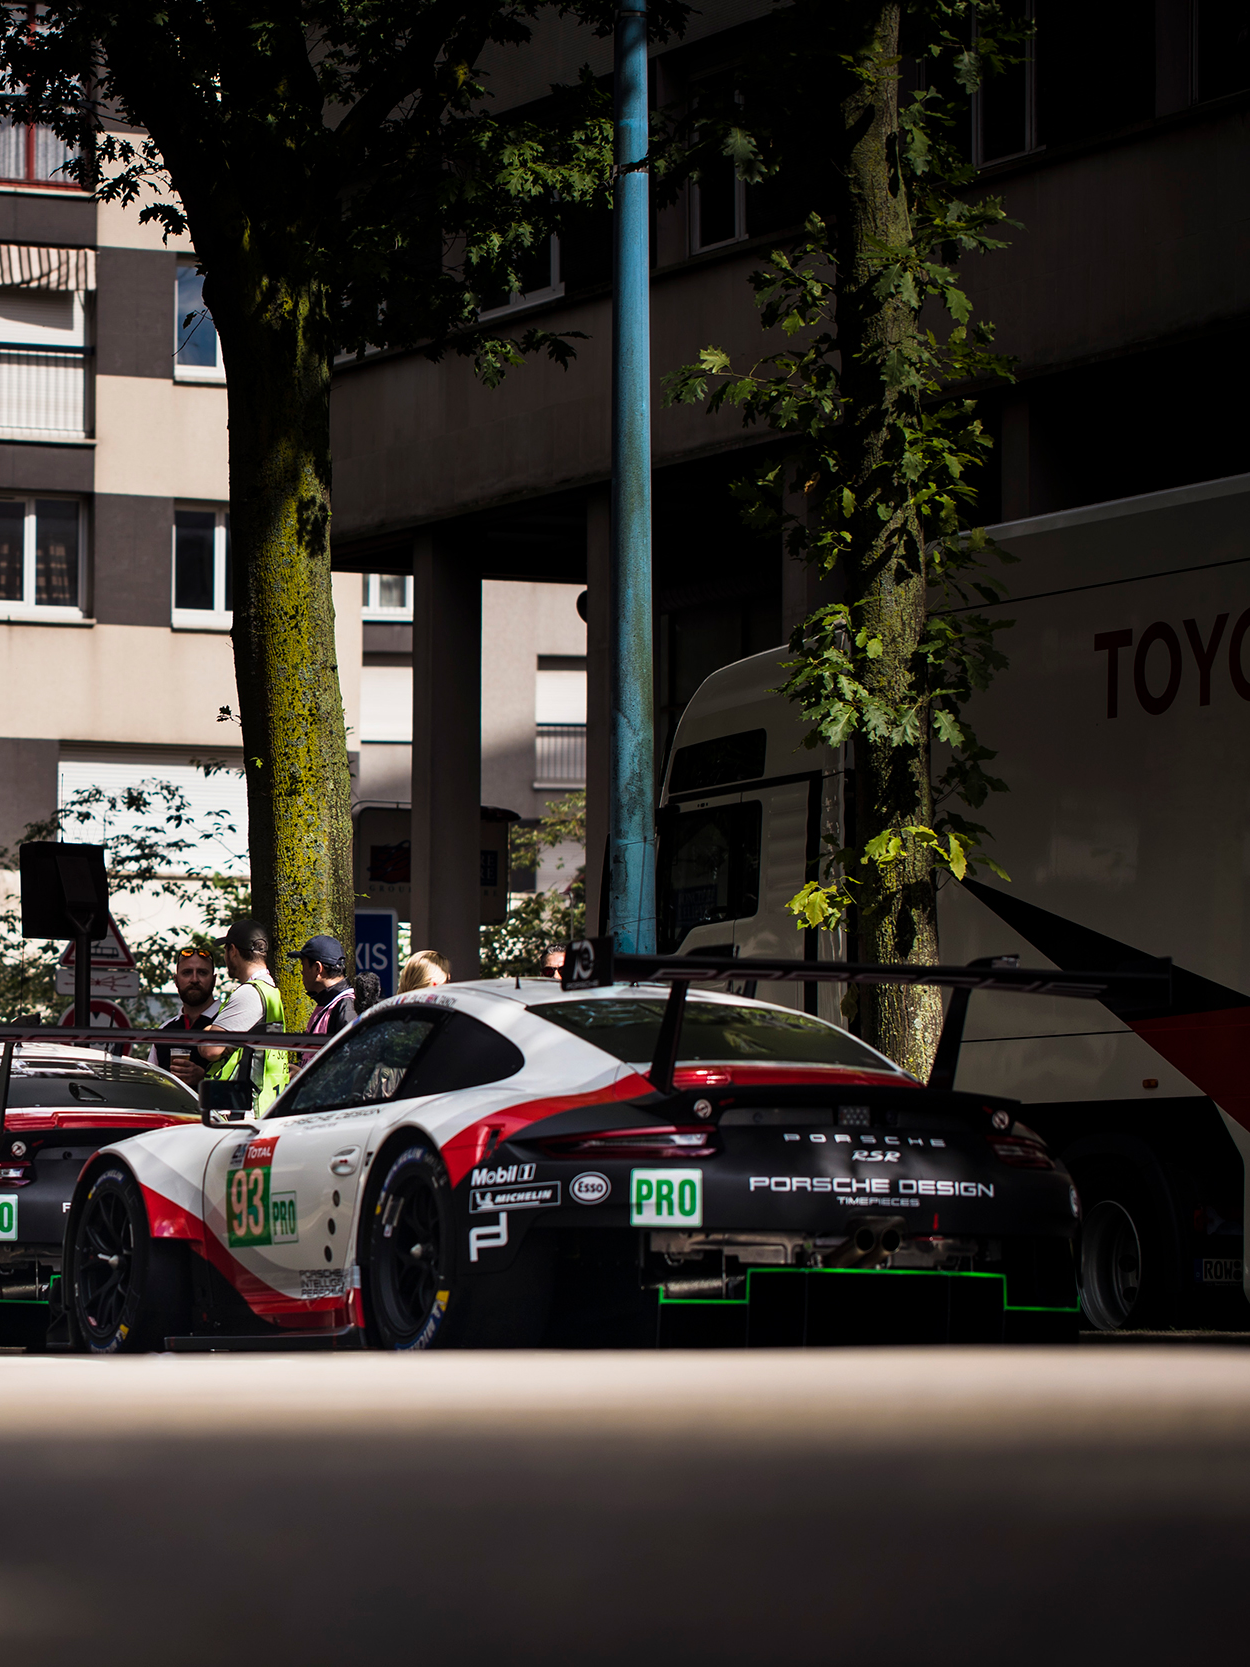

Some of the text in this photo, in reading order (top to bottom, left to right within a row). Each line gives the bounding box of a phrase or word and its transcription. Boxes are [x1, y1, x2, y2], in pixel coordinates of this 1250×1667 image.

[355, 942, 388, 970] XIS
[783, 1133, 946, 1148] PORSCHE
[247, 1146, 271, 1158] TOTAL
[851, 1150, 901, 1163] RSR
[470, 1164, 517, 1187] Mobil
[495, 1189, 552, 1204] MICHELIN
[578, 1181, 603, 1193] Esso
[749, 1177, 994, 1198] PORSCHE DESIGN
[231, 1168, 264, 1236] 93
[636, 1179, 696, 1217] PRO
[836, 1196, 921, 1207] TIMEPIECES
[272, 1199, 296, 1236] PRO
[1203, 1260, 1233, 1280] ROW
